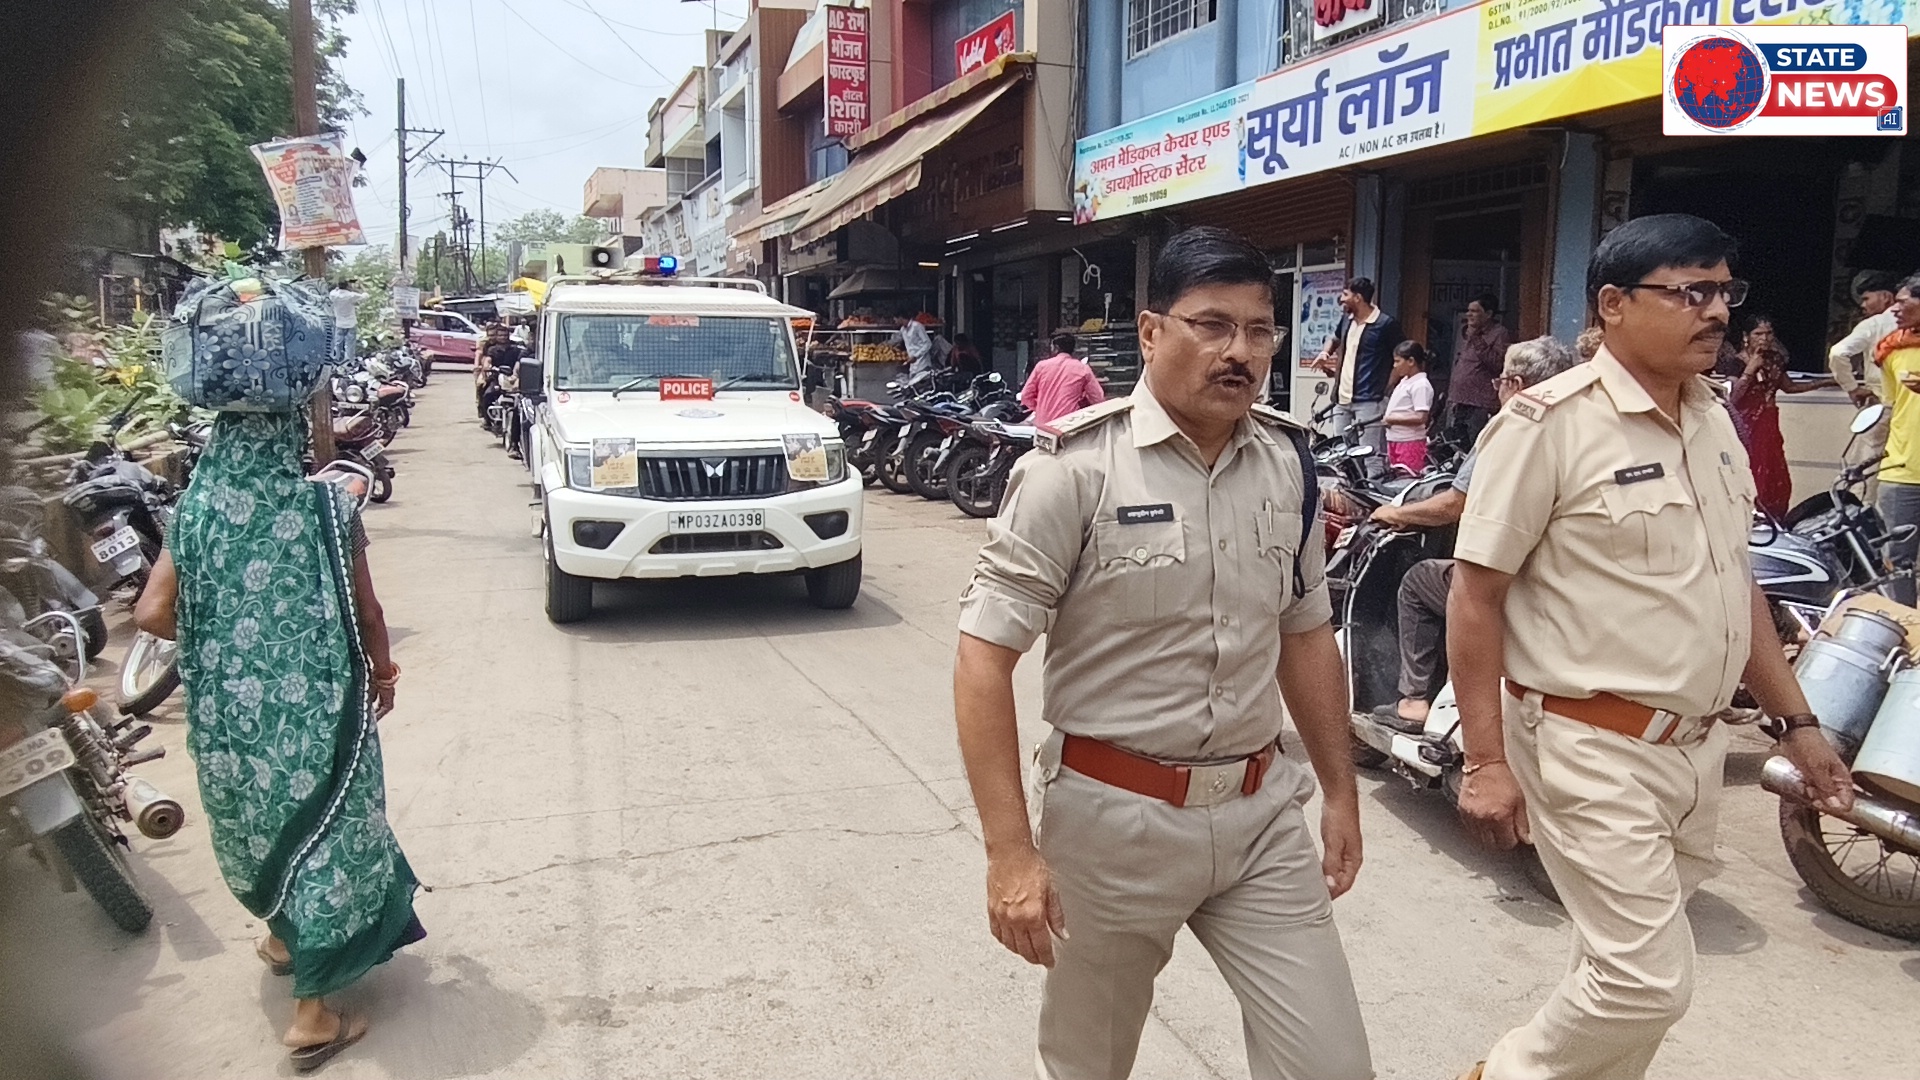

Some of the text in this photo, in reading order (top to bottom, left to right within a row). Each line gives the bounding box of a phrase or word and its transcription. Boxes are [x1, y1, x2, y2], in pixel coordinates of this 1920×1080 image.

[828, 10, 845, 30] AC
[831, 34, 862, 60] भोजन
[1494, 18, 1577, 90] प्रभात
[842, 88, 863, 102] होटल
[1247, 42, 1450, 175] सूर्या लॉज
[1090, 155, 1116, 175] अमन
[1117, 143, 1162, 166] मेडिकल
[1163, 133, 1199, 155] केयर
[1338, 145, 1350, 159] AC
[1358, 138, 1379, 155] NON
[1381, 135, 1394, 149] AC
[663, 382, 709, 395] POLICE
[677, 513, 762, 529] MP03ZA0398
[98, 535, 136, 560] 8013
